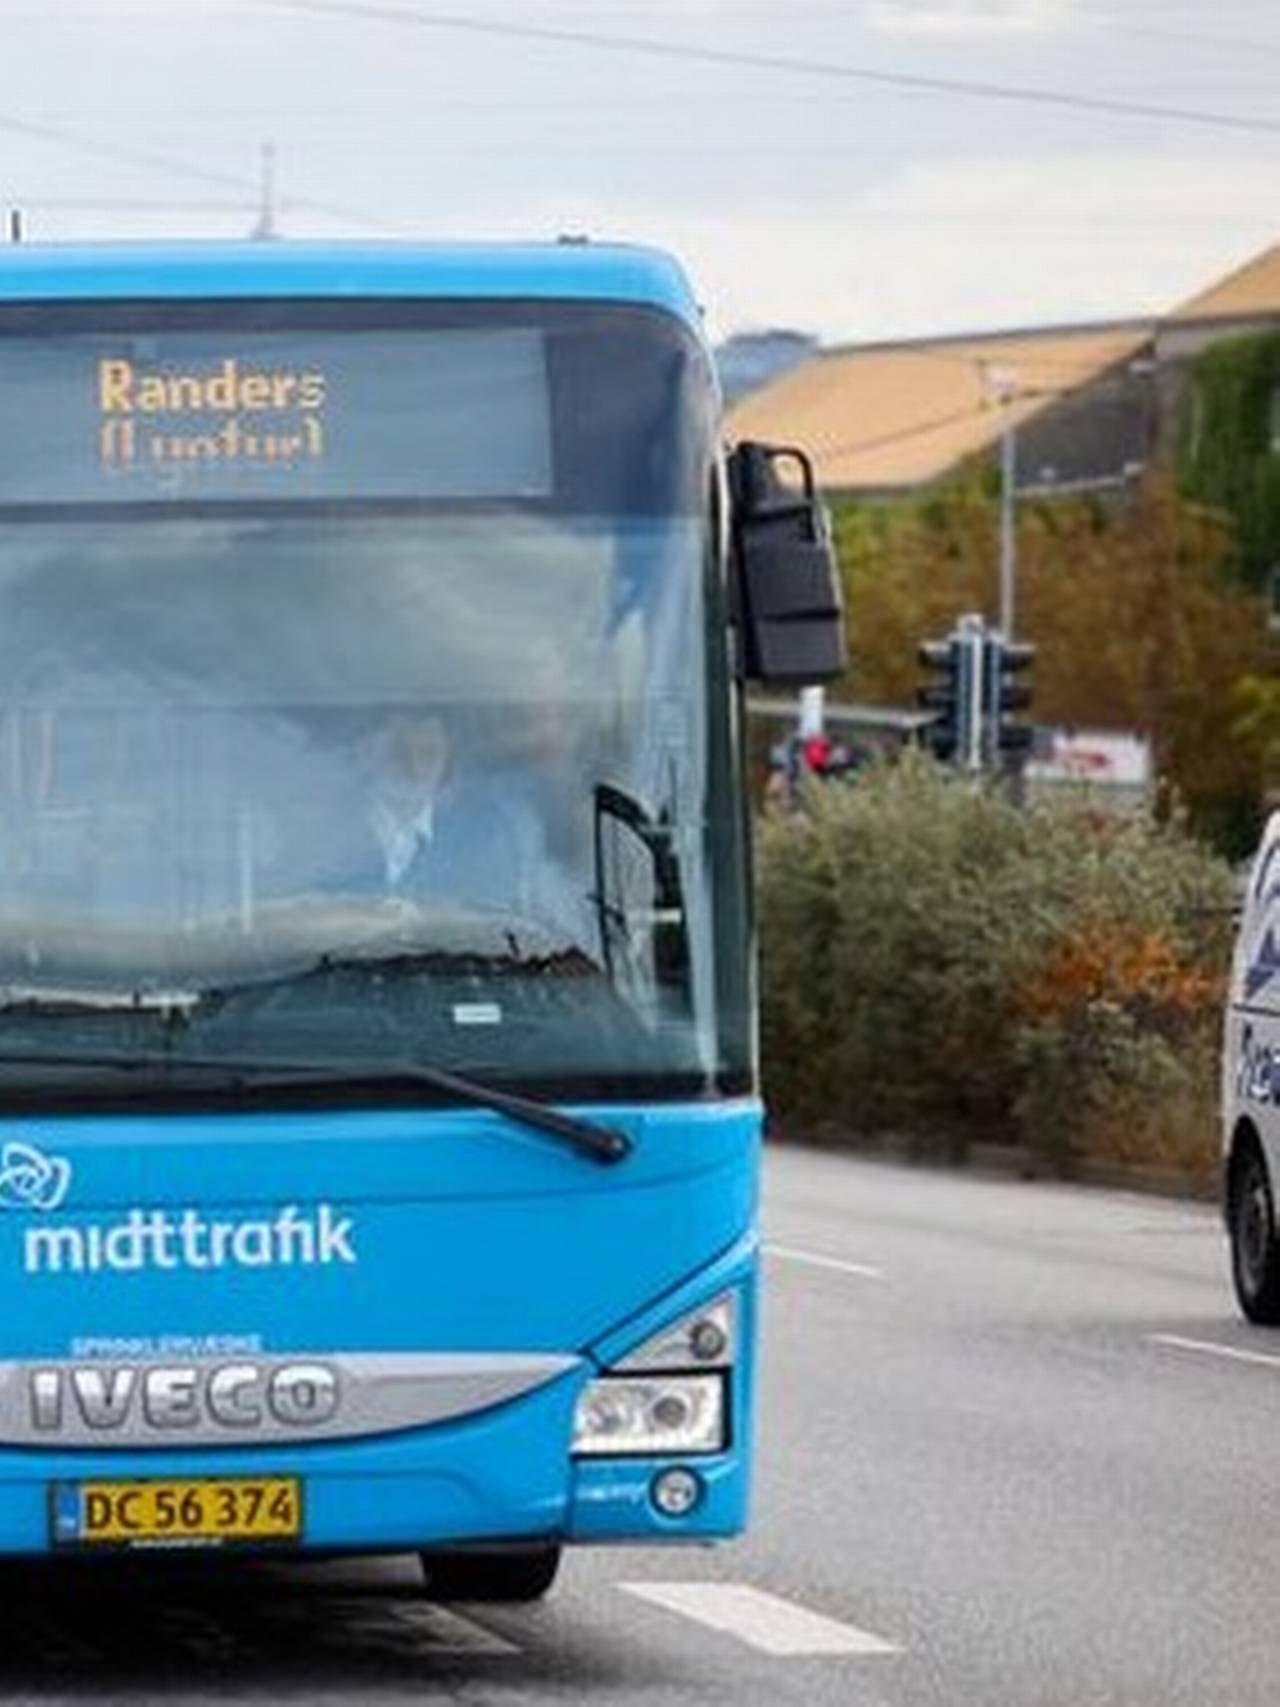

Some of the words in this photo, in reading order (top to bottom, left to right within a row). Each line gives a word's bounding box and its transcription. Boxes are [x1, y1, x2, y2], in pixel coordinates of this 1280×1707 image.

[99, 358, 326, 412] Randers
[23, 1203, 357, 1273] midttrafik
[29, 1361, 340, 1431] IVECO
[85, 1490, 143, 1530] DC
[153, 1488, 204, 1529] 56
[214, 1486, 293, 1527] 374
